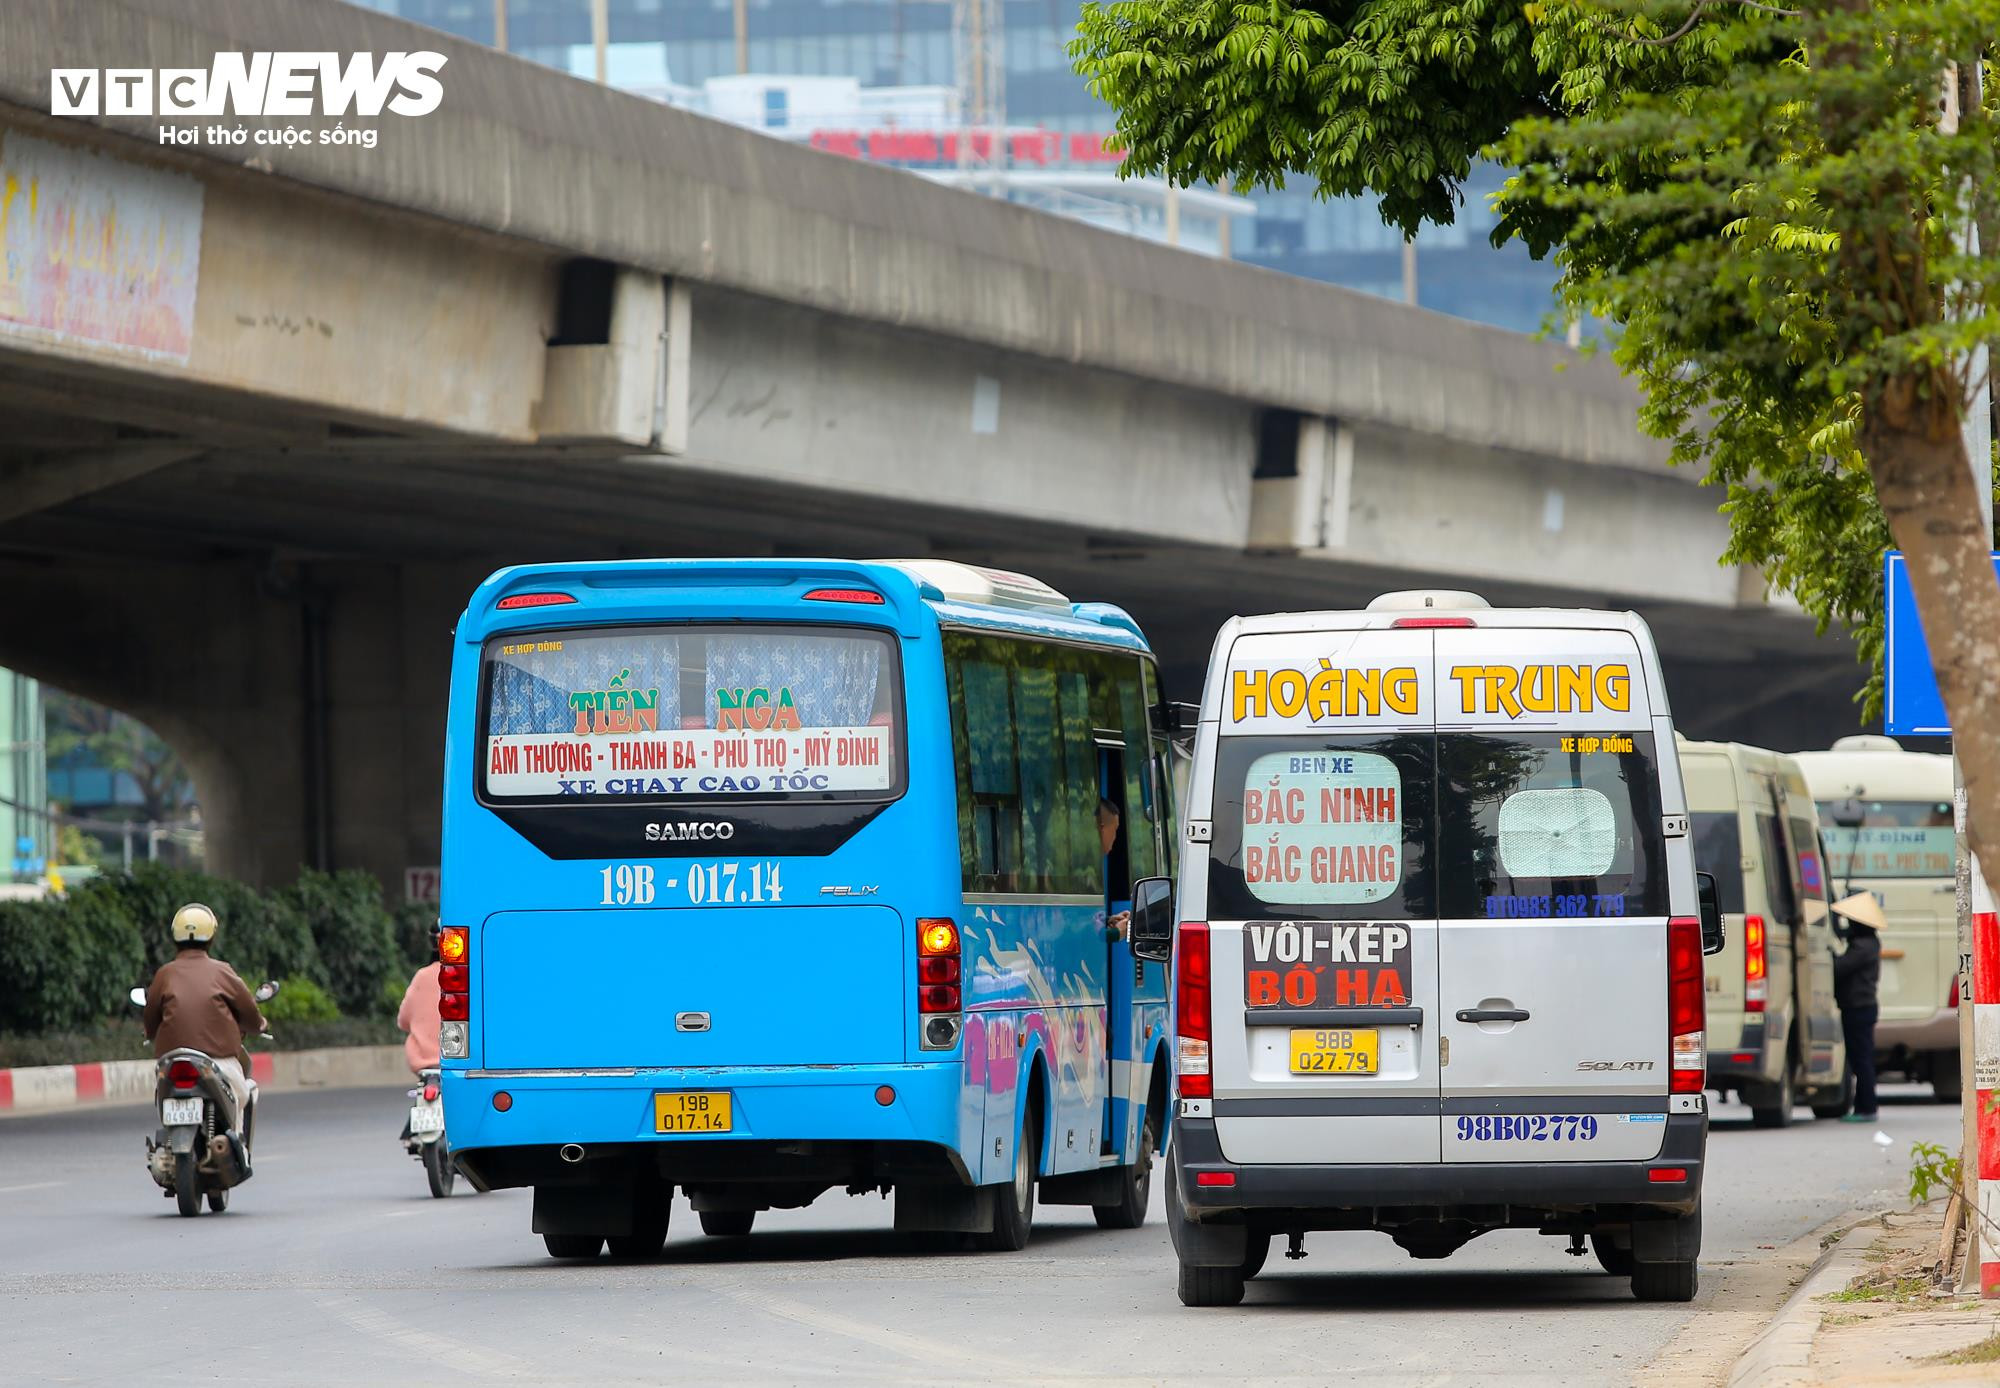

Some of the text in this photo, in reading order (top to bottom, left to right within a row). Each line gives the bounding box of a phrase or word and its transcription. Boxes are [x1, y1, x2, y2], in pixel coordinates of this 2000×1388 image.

[503, 645, 515, 656] XE
[568, 667, 802, 736] TIẾN NGA
[1232, 657, 1631, 723] HOÀNG TRUNG
[490, 737, 519, 774] ẤM
[523, 740, 593, 779] THƯỢNG
[609, 740, 668, 771] THANH
[672, 739, 697, 769] BA
[713, 731, 749, 769] PHÚ
[753, 737, 787, 773] THỌ
[804, 730, 832, 767] MỸ
[836, 729, 879, 766] ĐÌNH
[1560, 733, 1633, 756] XE HỢP ĐỒNG
[1331, 757, 1354, 774] XE
[557, 779, 597, 795] XE
[698, 775, 761, 792] CAO
[769, 767, 829, 791] TỐC
[1245, 774, 1396, 825] BẮC NINH
[645, 821, 735, 841] SAMCO
[1246, 831, 1396, 884] BẮC GIANG
[600, 863, 656, 905] 19B
[687, 860, 784, 904] 017.14
[819, 884, 880, 897] FELIX
[1555, 895, 1588, 918] 362
[1592, 894, 1625, 917] 779
[1249, 921, 1409, 963] VÔI-KÉP
[1247, 962, 1407, 1009] BỐ HẠ
[1315, 1031, 1353, 1050] 98B
[1299, 1052, 1369, 1070] 027.79
[1575, 1061, 1656, 1071] SOLATI
[678, 1095, 709, 1111] 19B
[663, 1113, 723, 1130] 017.14
[1456, 1115, 1599, 1141] 98B02779
